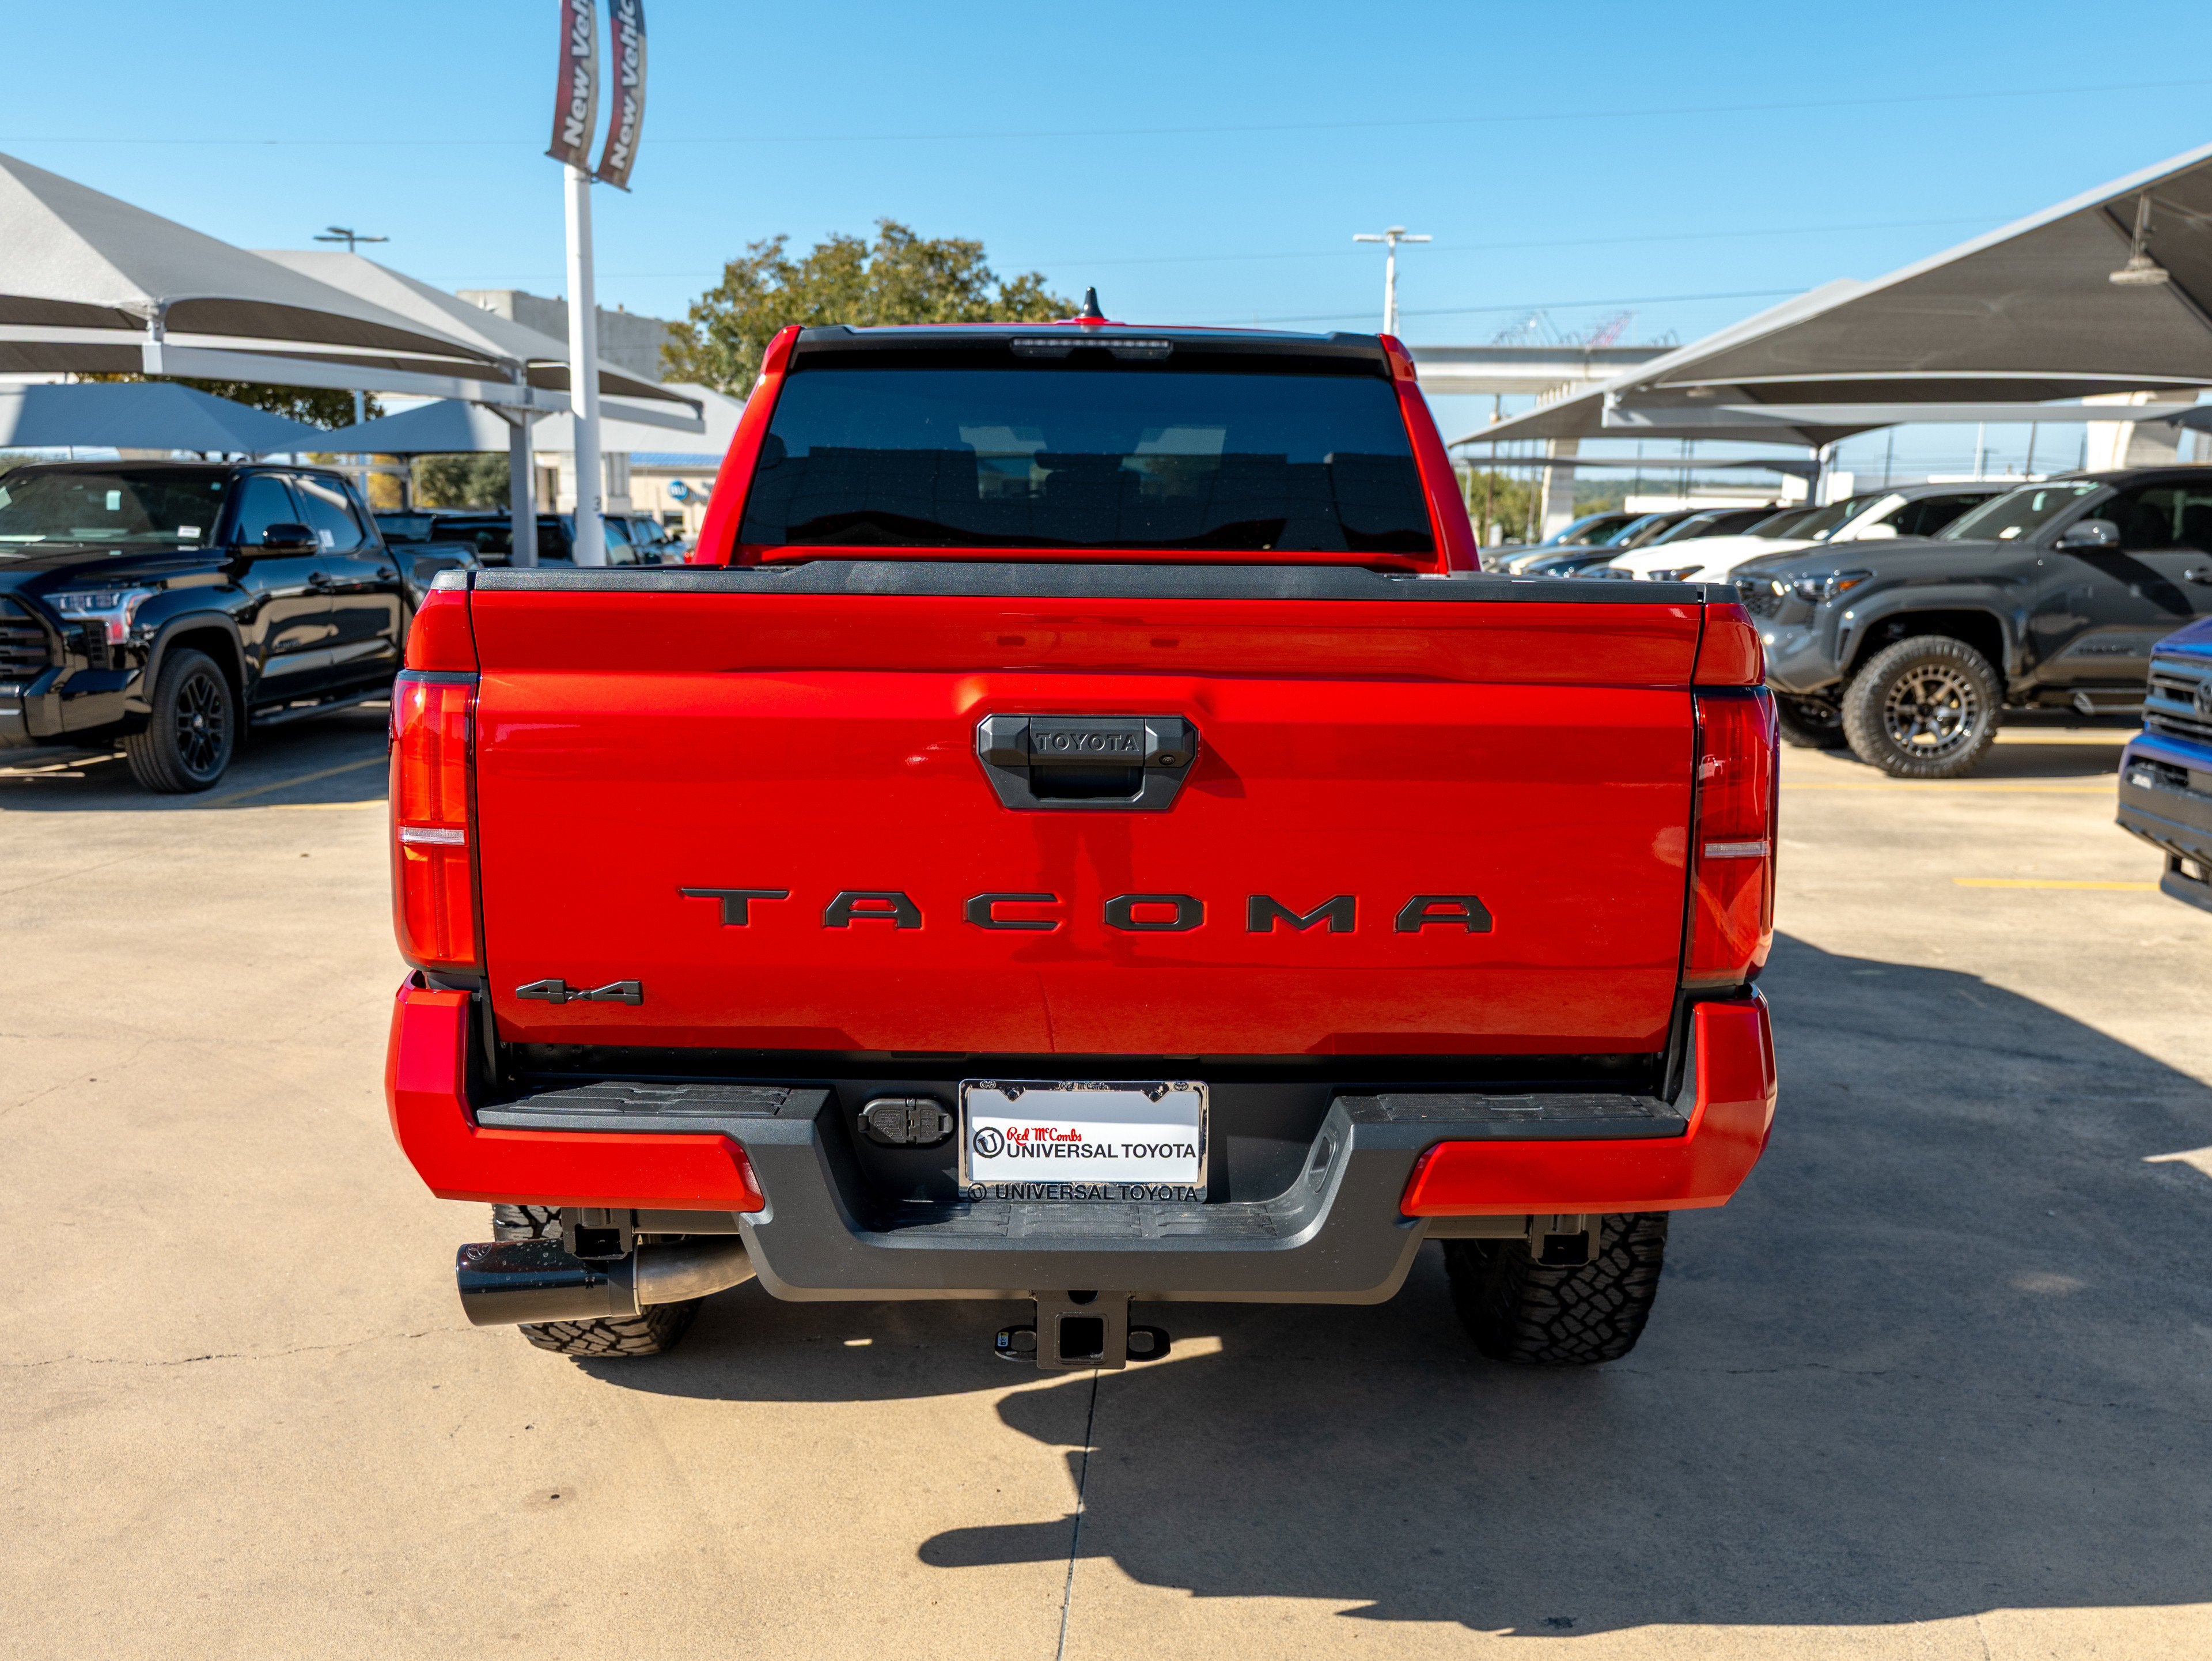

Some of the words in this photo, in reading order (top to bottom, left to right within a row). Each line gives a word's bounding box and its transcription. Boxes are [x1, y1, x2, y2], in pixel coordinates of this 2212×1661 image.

[562, 63, 590, 148] New
[609, 94, 638, 171] New
[1036, 733, 1139, 751] TOYOTA
[681, 888, 1495, 934] TACOMA
[516, 979, 643, 1005] 4x4
[1007, 1126, 1029, 1146] Red
[1031, 1127, 1082, 1142] McCombs
[1007, 1143, 1118, 1158] UNIVERSAL
[1121, 1144, 1196, 1158] TOYOTA
[995, 1183, 1114, 1200] UNIVERSAL
[1117, 1185, 1198, 1201] TOYOTA
